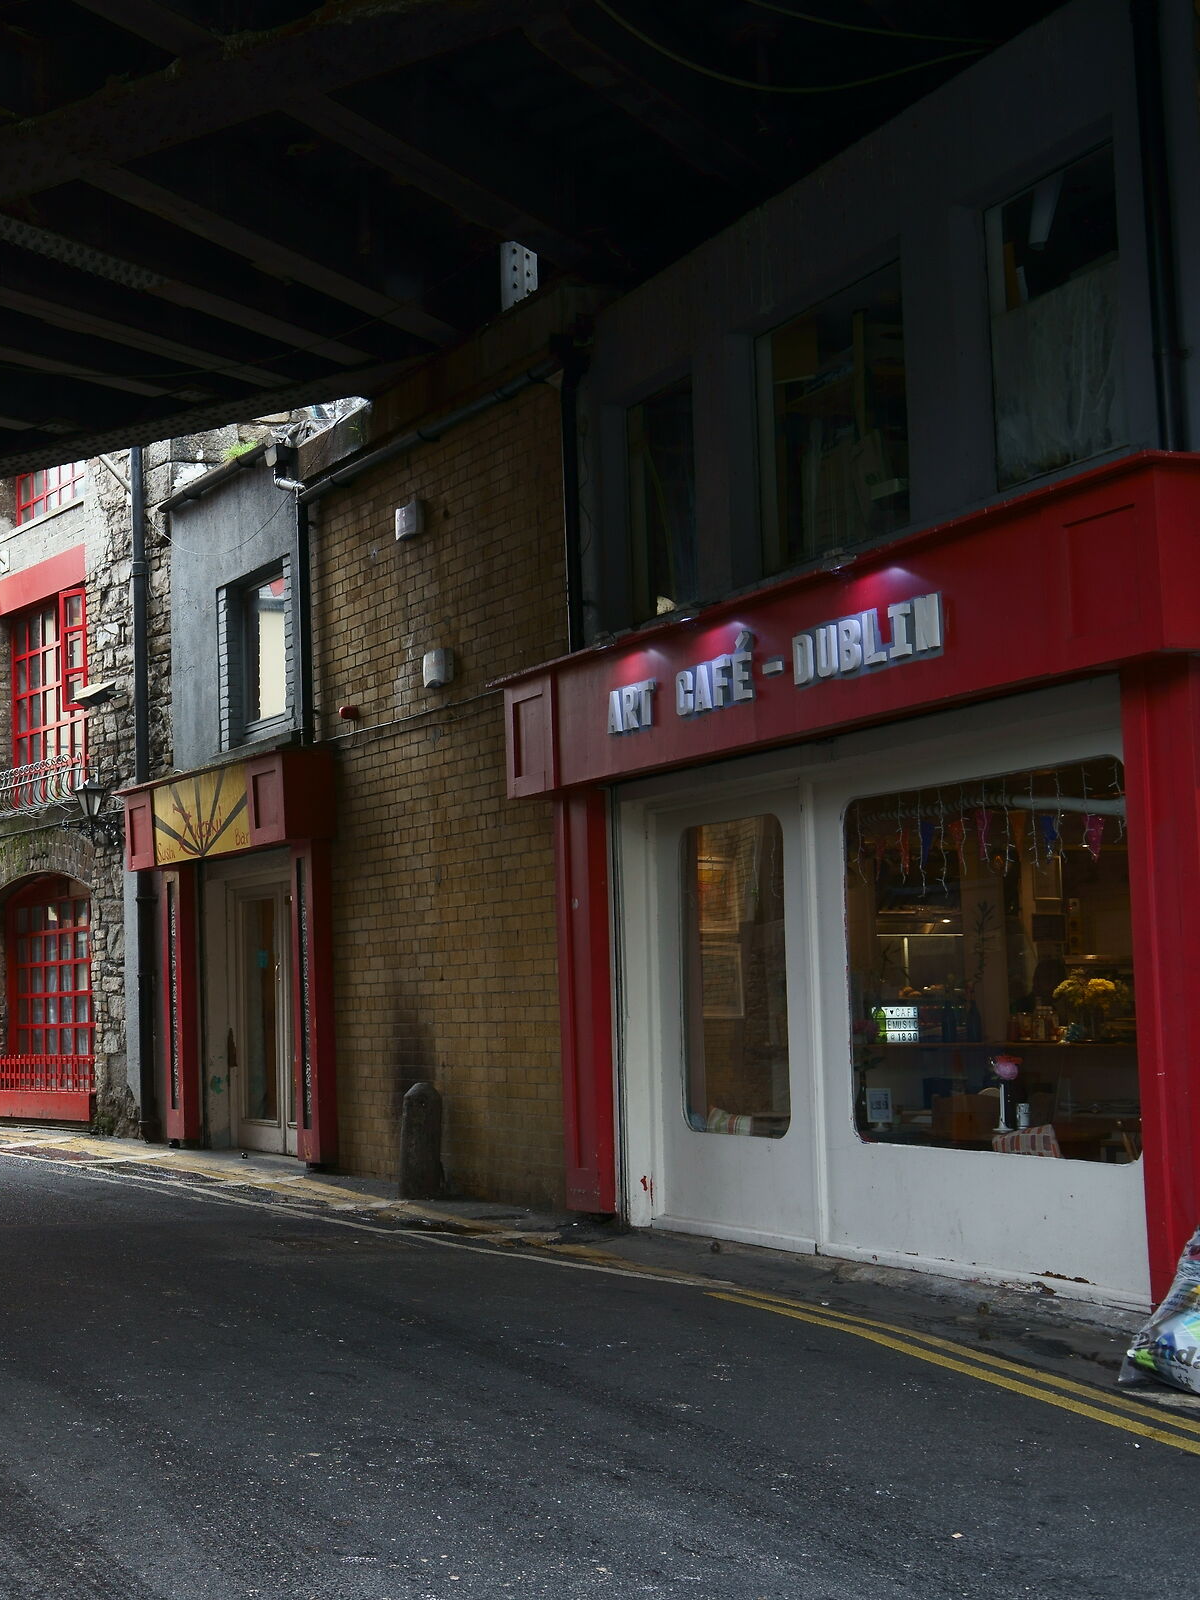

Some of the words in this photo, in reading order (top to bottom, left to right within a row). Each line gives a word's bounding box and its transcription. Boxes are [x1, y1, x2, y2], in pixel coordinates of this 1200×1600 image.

[608, 680, 655, 736] ART
[675, 630, 753, 717] CAFÉ
[792, 592, 942, 686] DUBLIN
[234, 827, 249, 846] Bar
